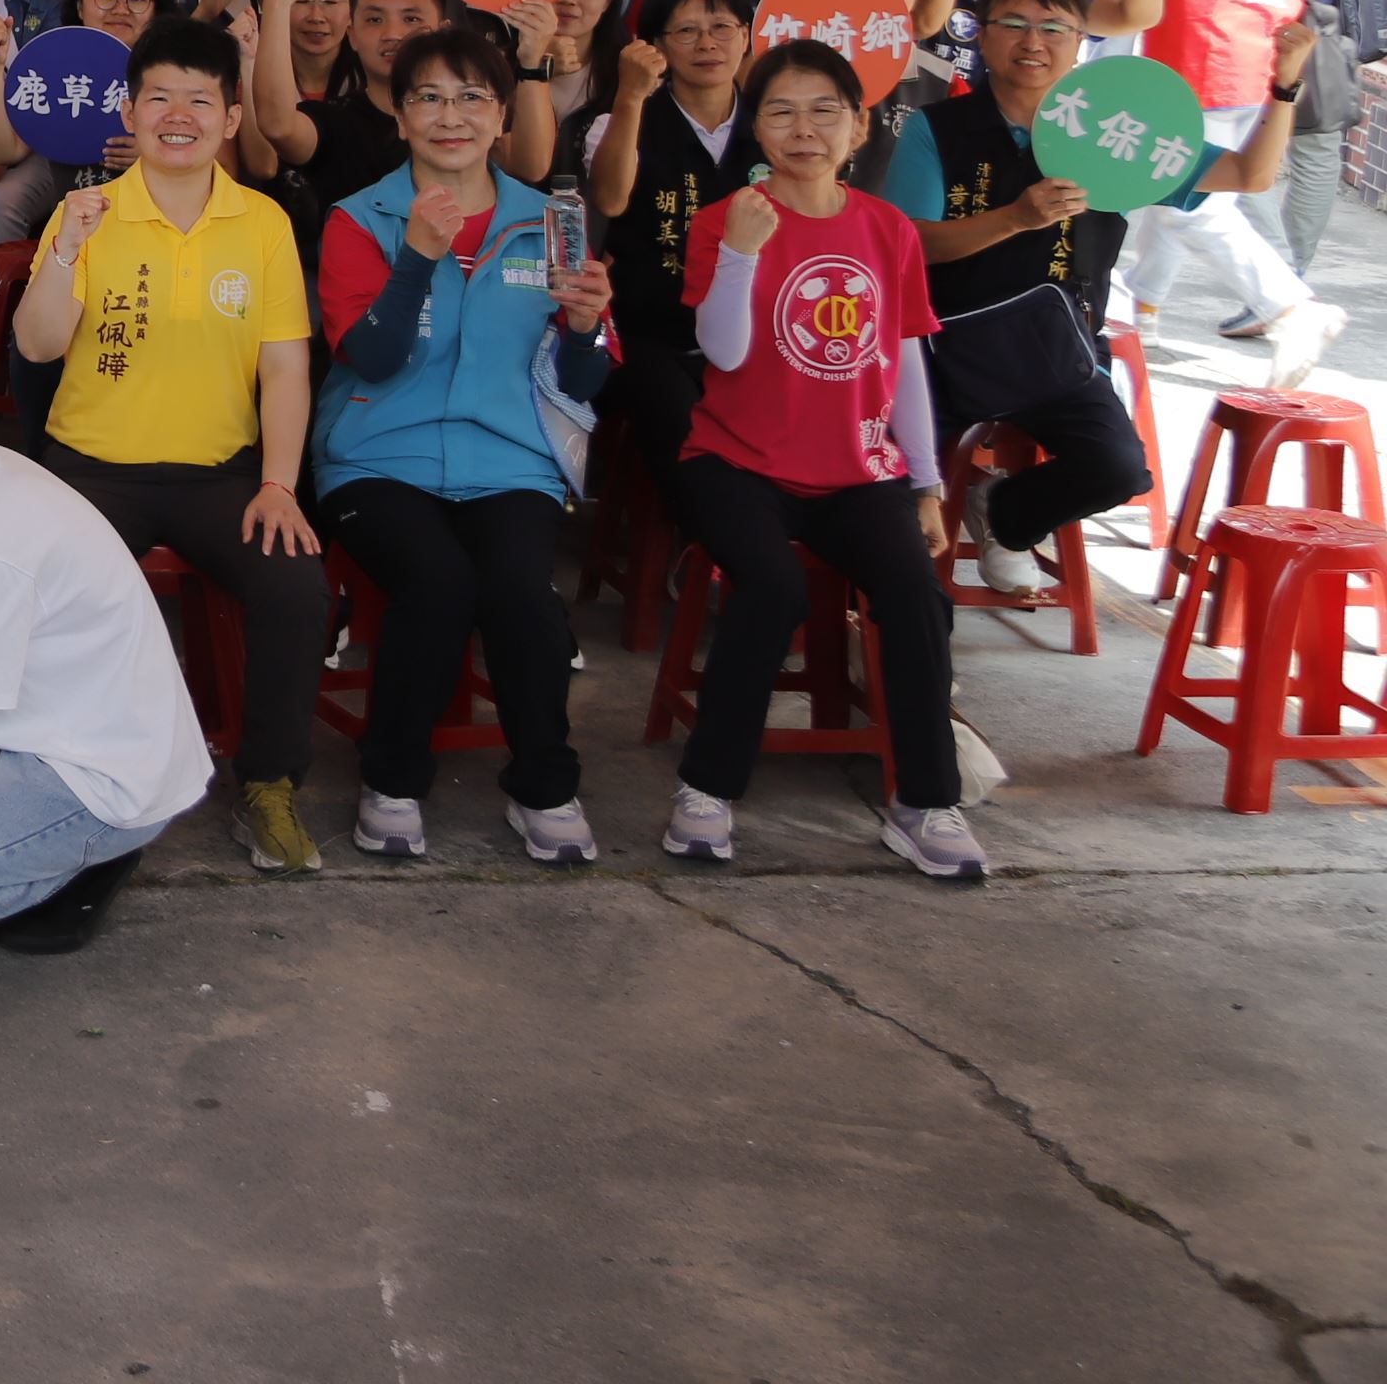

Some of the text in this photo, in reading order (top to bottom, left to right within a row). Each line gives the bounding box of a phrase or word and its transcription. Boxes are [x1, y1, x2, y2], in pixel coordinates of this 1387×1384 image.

[1040, 87, 1195, 182] 太保市
[96, 288, 133, 382] 江佩曄
[135, 263, 150, 341] 嘉義縣議員
[774, 338, 806, 373] CENTERS
[802, 367, 822, 380] FOR
